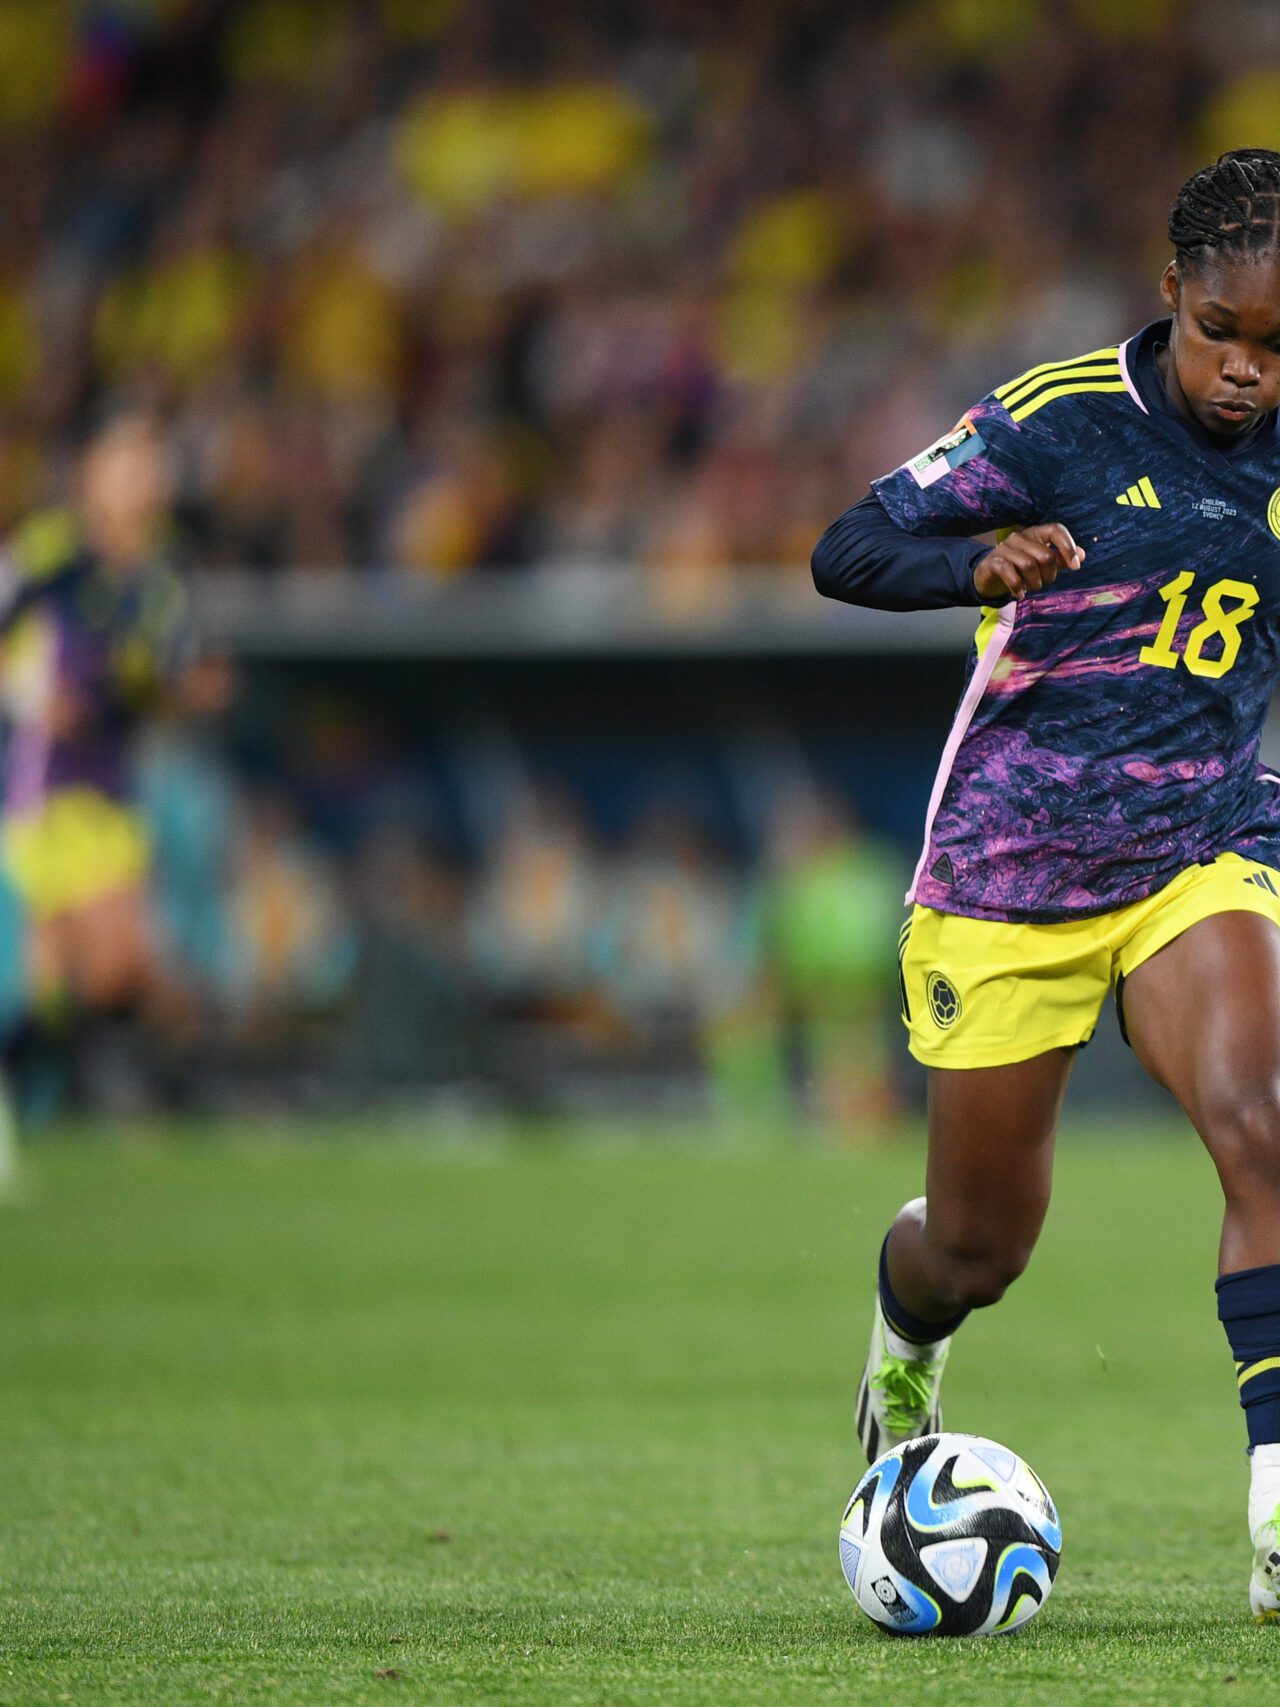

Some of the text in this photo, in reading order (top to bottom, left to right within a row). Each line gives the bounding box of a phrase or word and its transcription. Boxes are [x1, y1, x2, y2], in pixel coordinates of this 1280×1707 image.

[1191, 502, 1237, 516] 12 AUGUST 2023
[1138, 570, 1260, 679] 18
